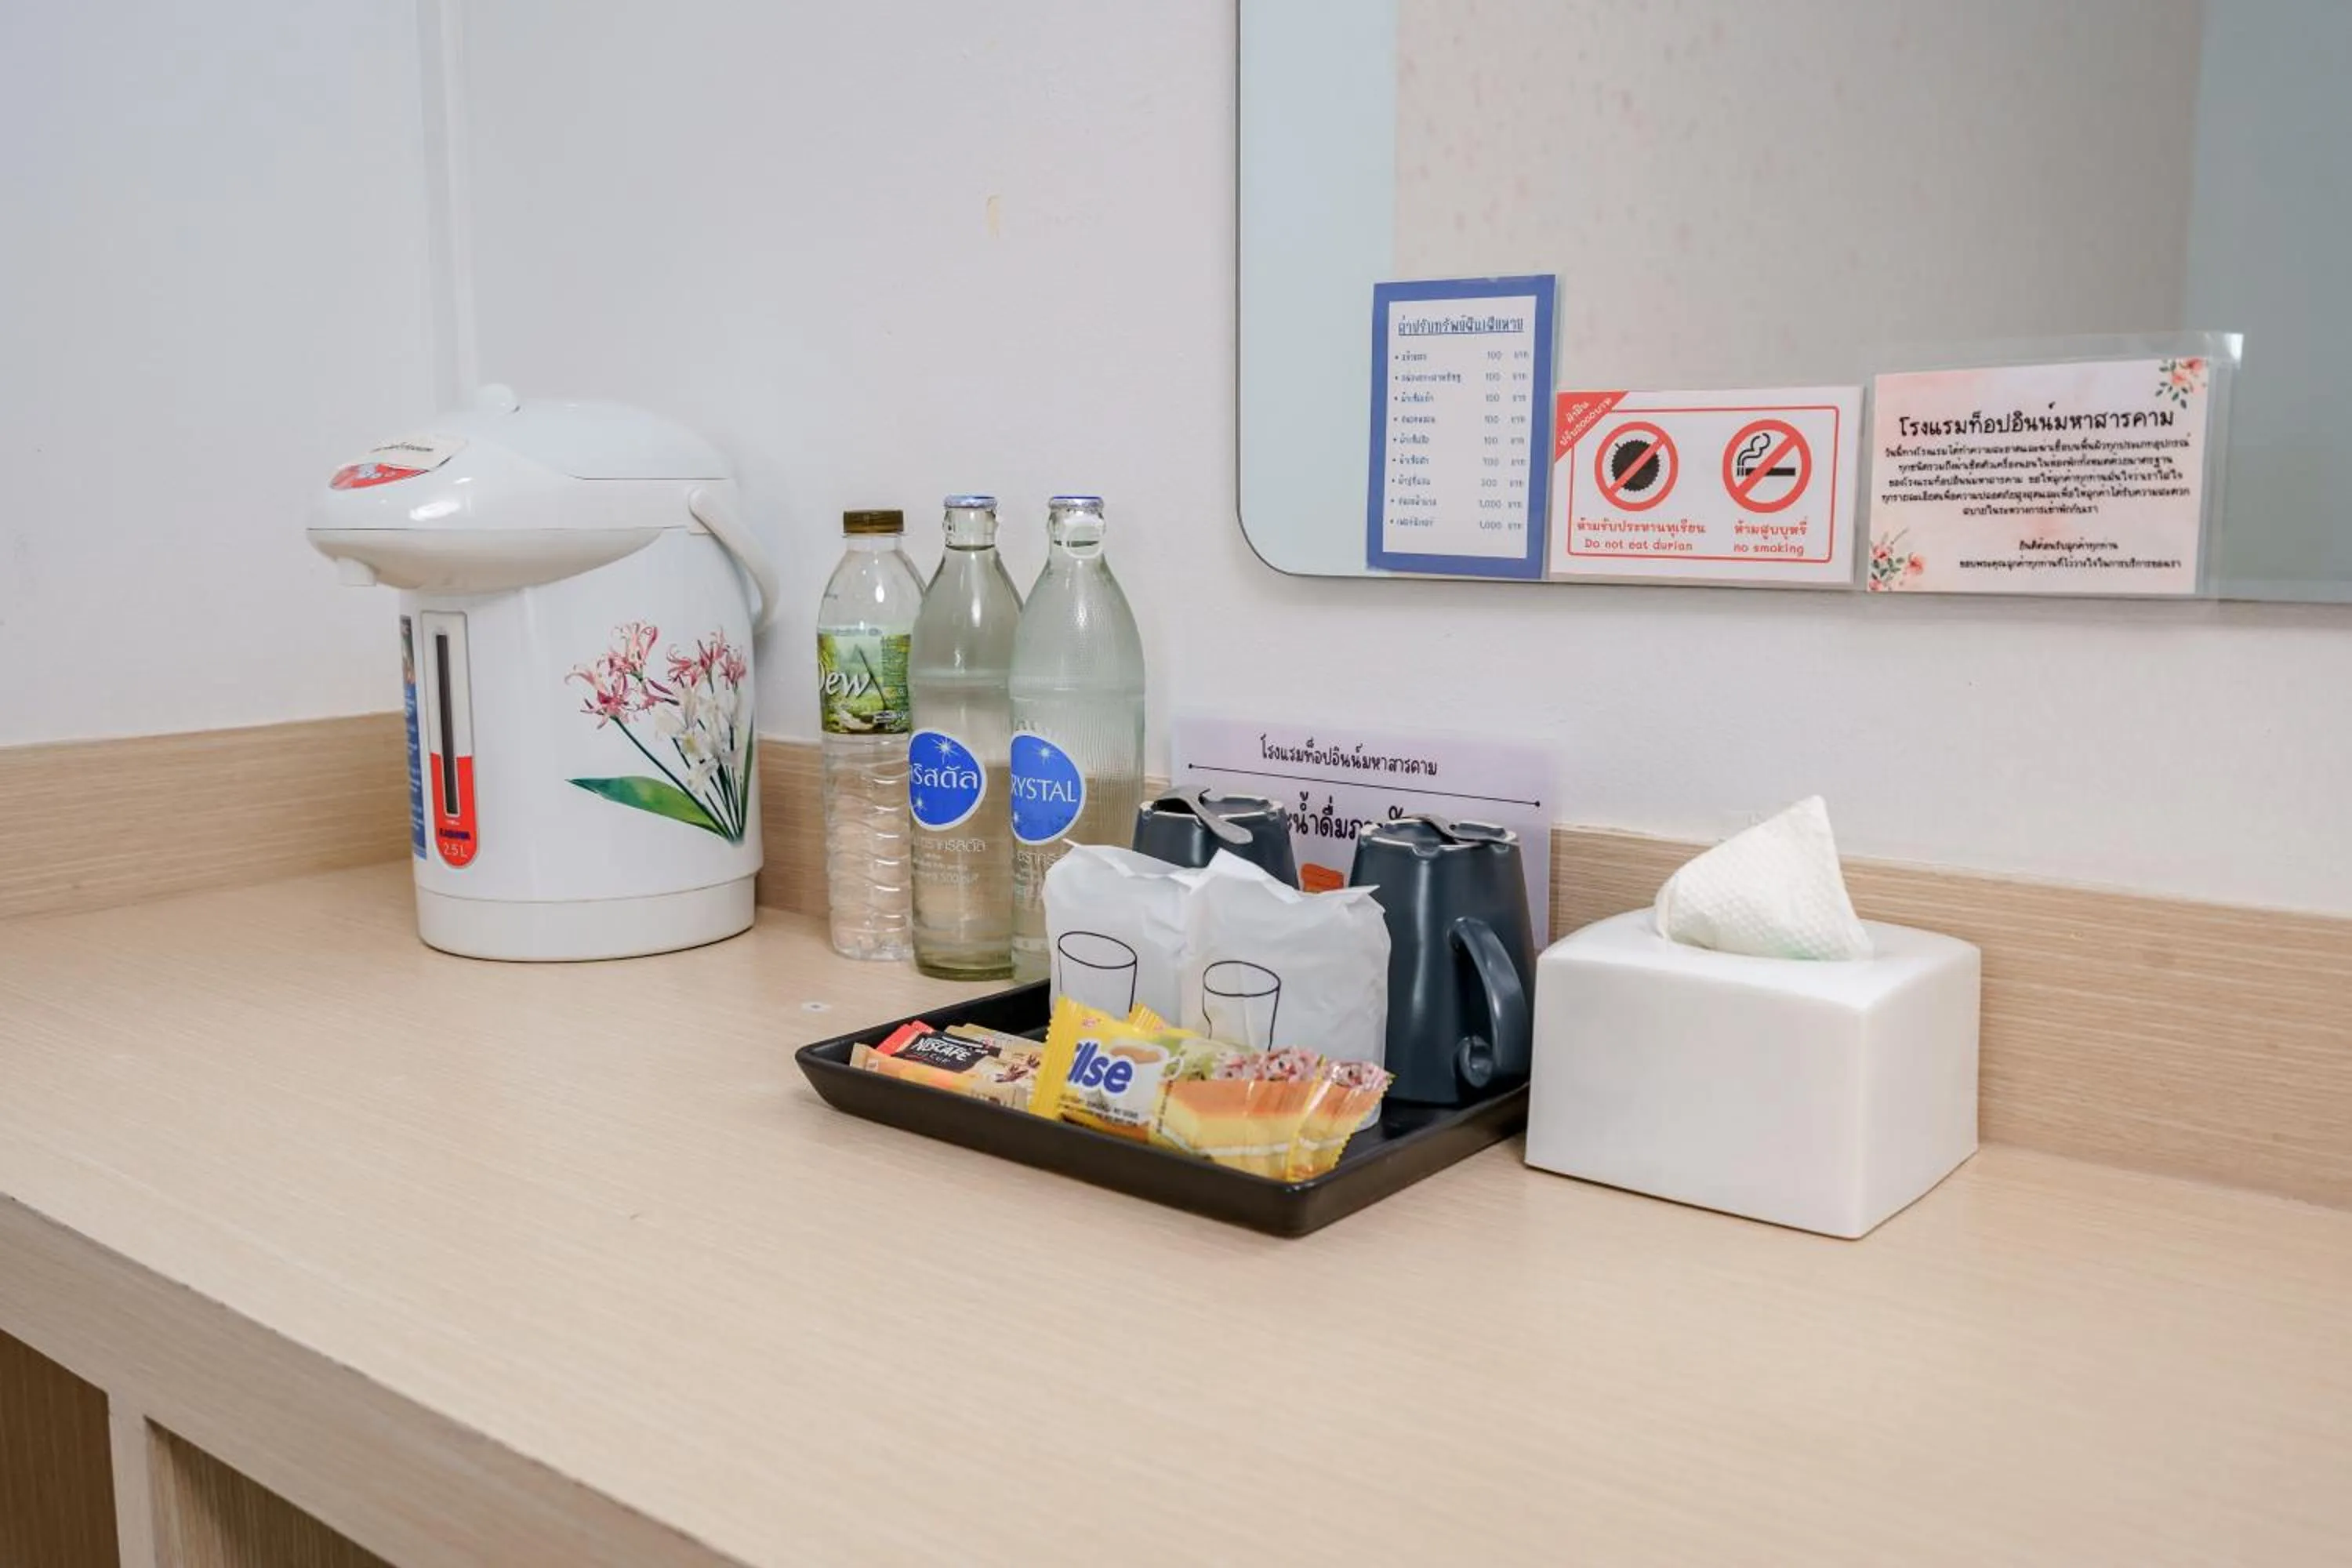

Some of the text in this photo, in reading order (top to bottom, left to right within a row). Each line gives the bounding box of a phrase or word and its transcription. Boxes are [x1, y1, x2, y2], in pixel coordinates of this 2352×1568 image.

[1898, 401, 2175, 437] โรงแรมท็อปอินน์มหาสารคาม
[1577, 517, 1707, 538] ห้ามรับประทานทุเรียน
[1734, 515, 1808, 539] ห้ามสูบบุหรี่
[1584, 539, 1693, 550] Do not eat durian
[1733, 543, 1804, 557] no smoking
[1261, 734, 1437, 775] โรงแรมท็อปอินน์มหาสารคาม
[909, 763, 978, 789] ริสตัล
[1011, 774, 1076, 803] RYSTAL
